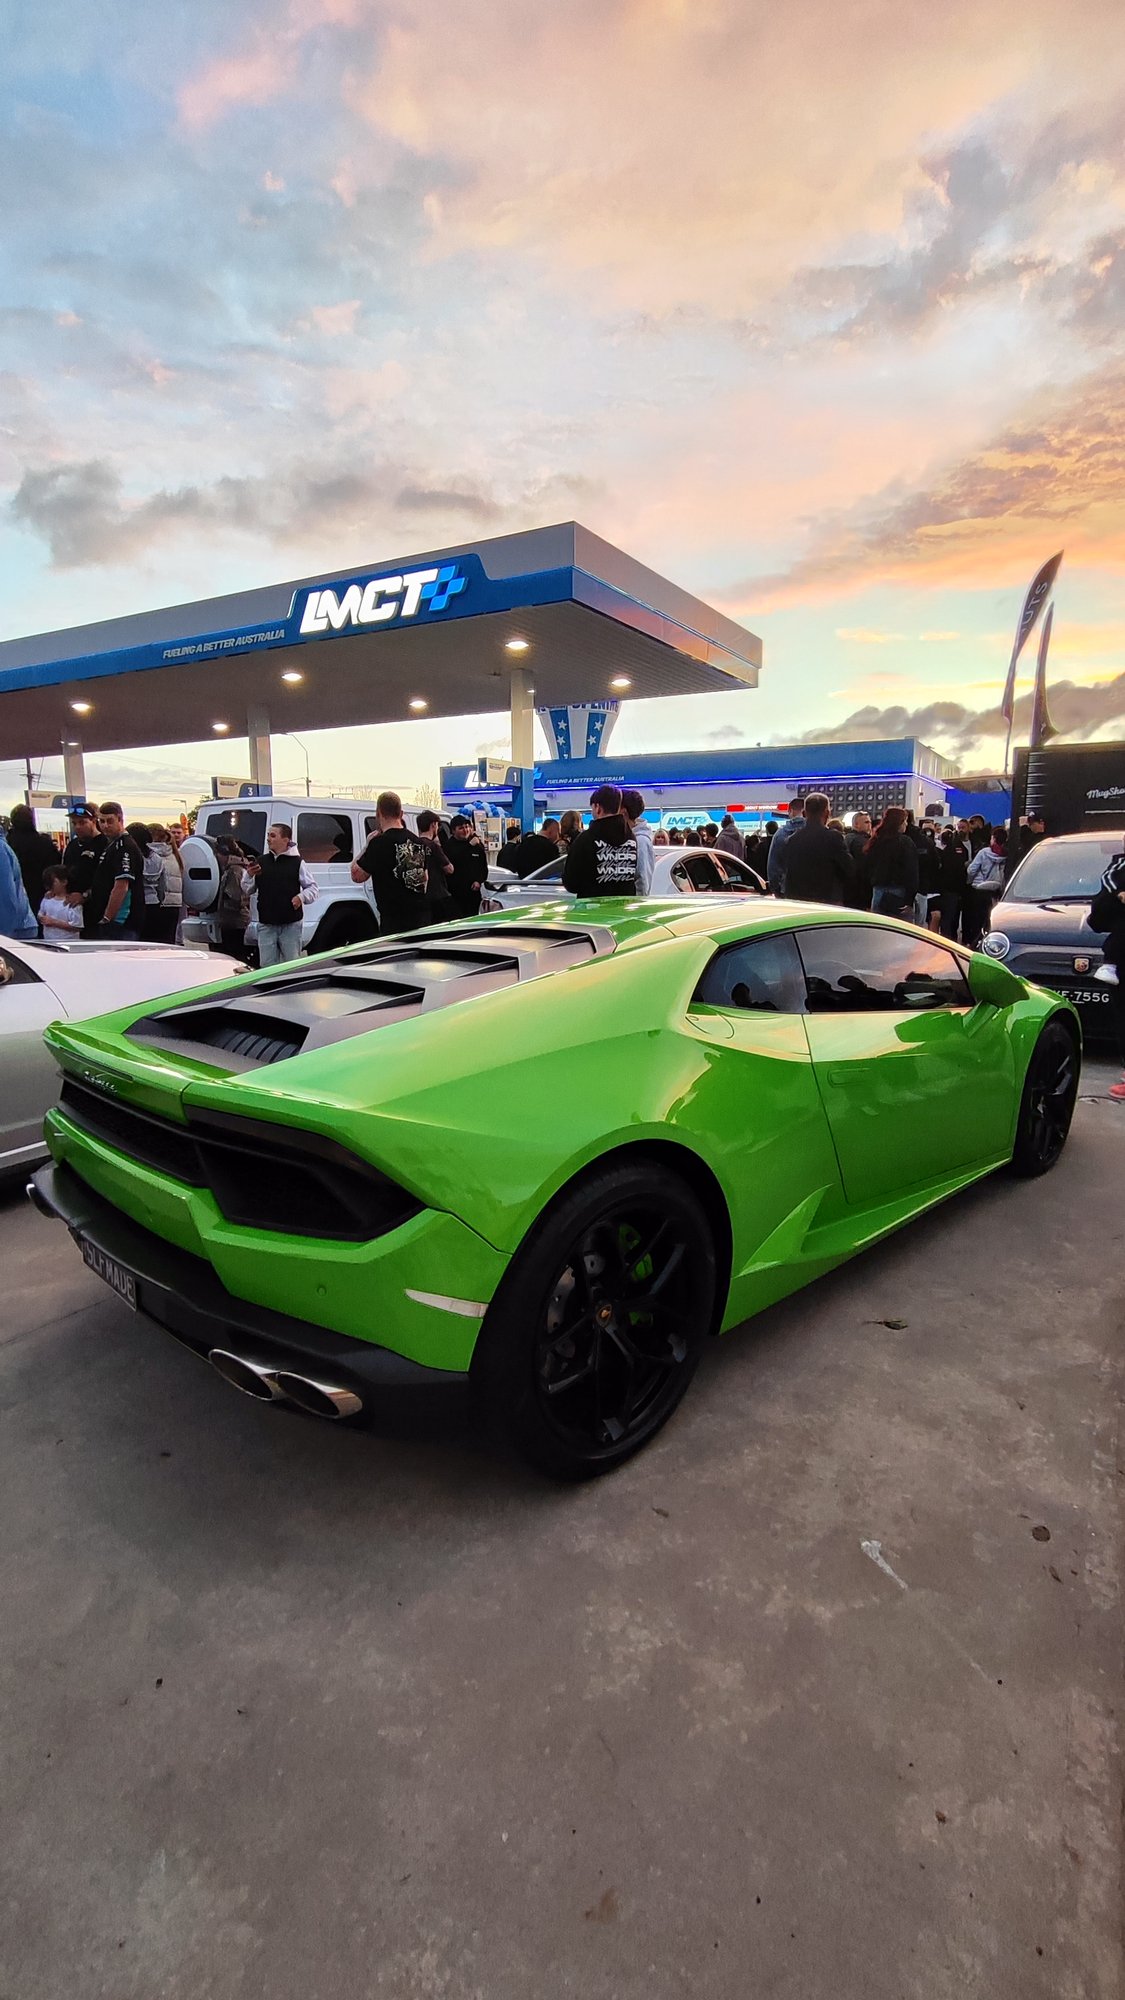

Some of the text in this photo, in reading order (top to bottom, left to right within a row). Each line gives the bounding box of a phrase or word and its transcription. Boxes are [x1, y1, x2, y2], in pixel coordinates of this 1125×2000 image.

[163, 645, 196, 659] FUELING
[203, 639, 236, 652] BETTER
[235, 629, 285, 646] AUSTRALIA
[513, 771, 517, 782] 1
[594, 775, 625, 783] AUSTRALIA
[247, 786, 254, 796] 3
[61, 798, 68, 807] 5
